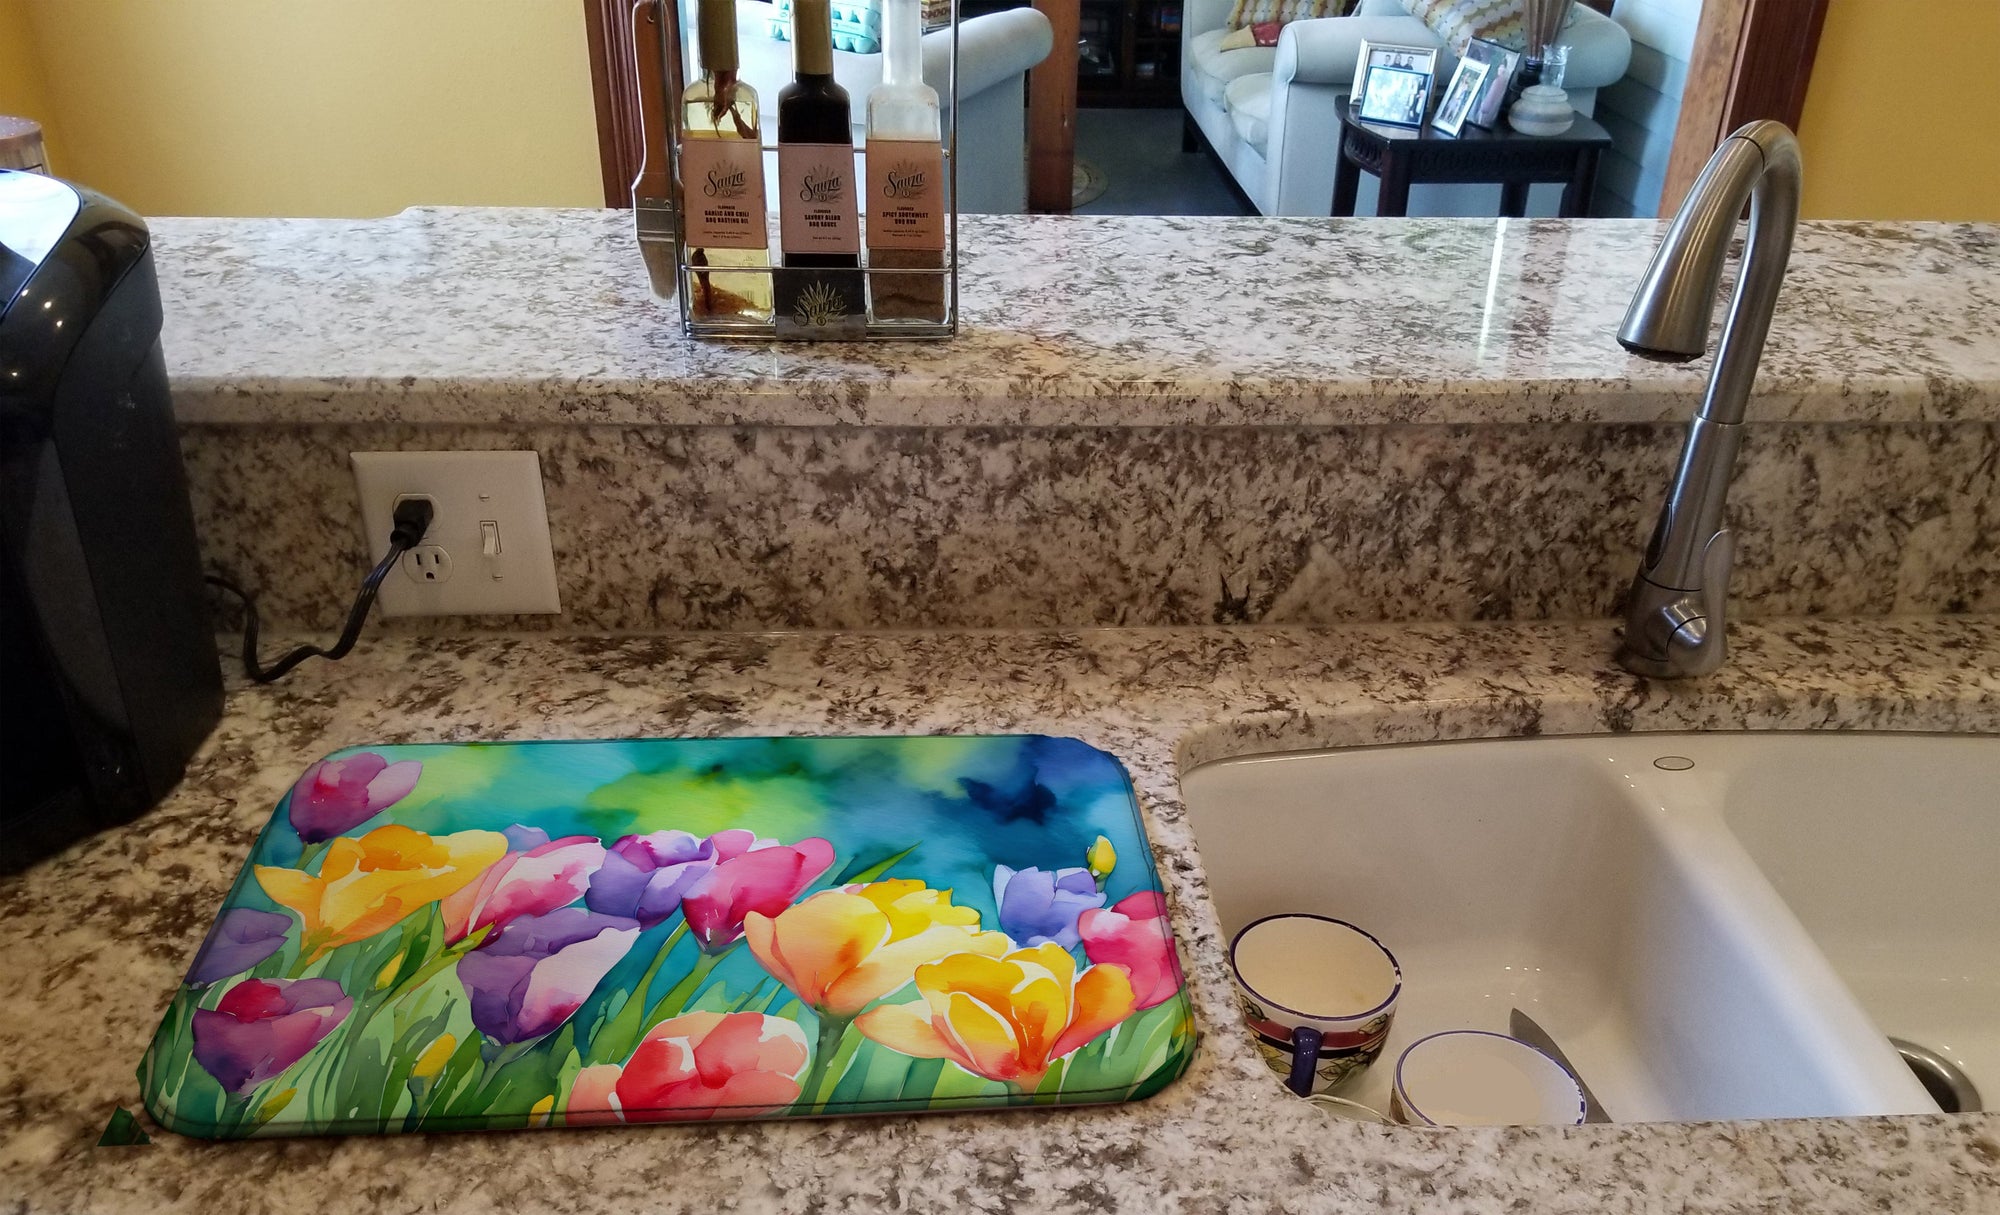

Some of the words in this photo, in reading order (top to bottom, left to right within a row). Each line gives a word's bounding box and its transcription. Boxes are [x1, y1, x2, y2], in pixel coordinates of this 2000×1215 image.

[703, 169, 746, 197] Sauza
[799, 175, 842, 202] Sauza
[883, 170, 926, 198] Sauza
[792, 295, 845, 327] Sauza
